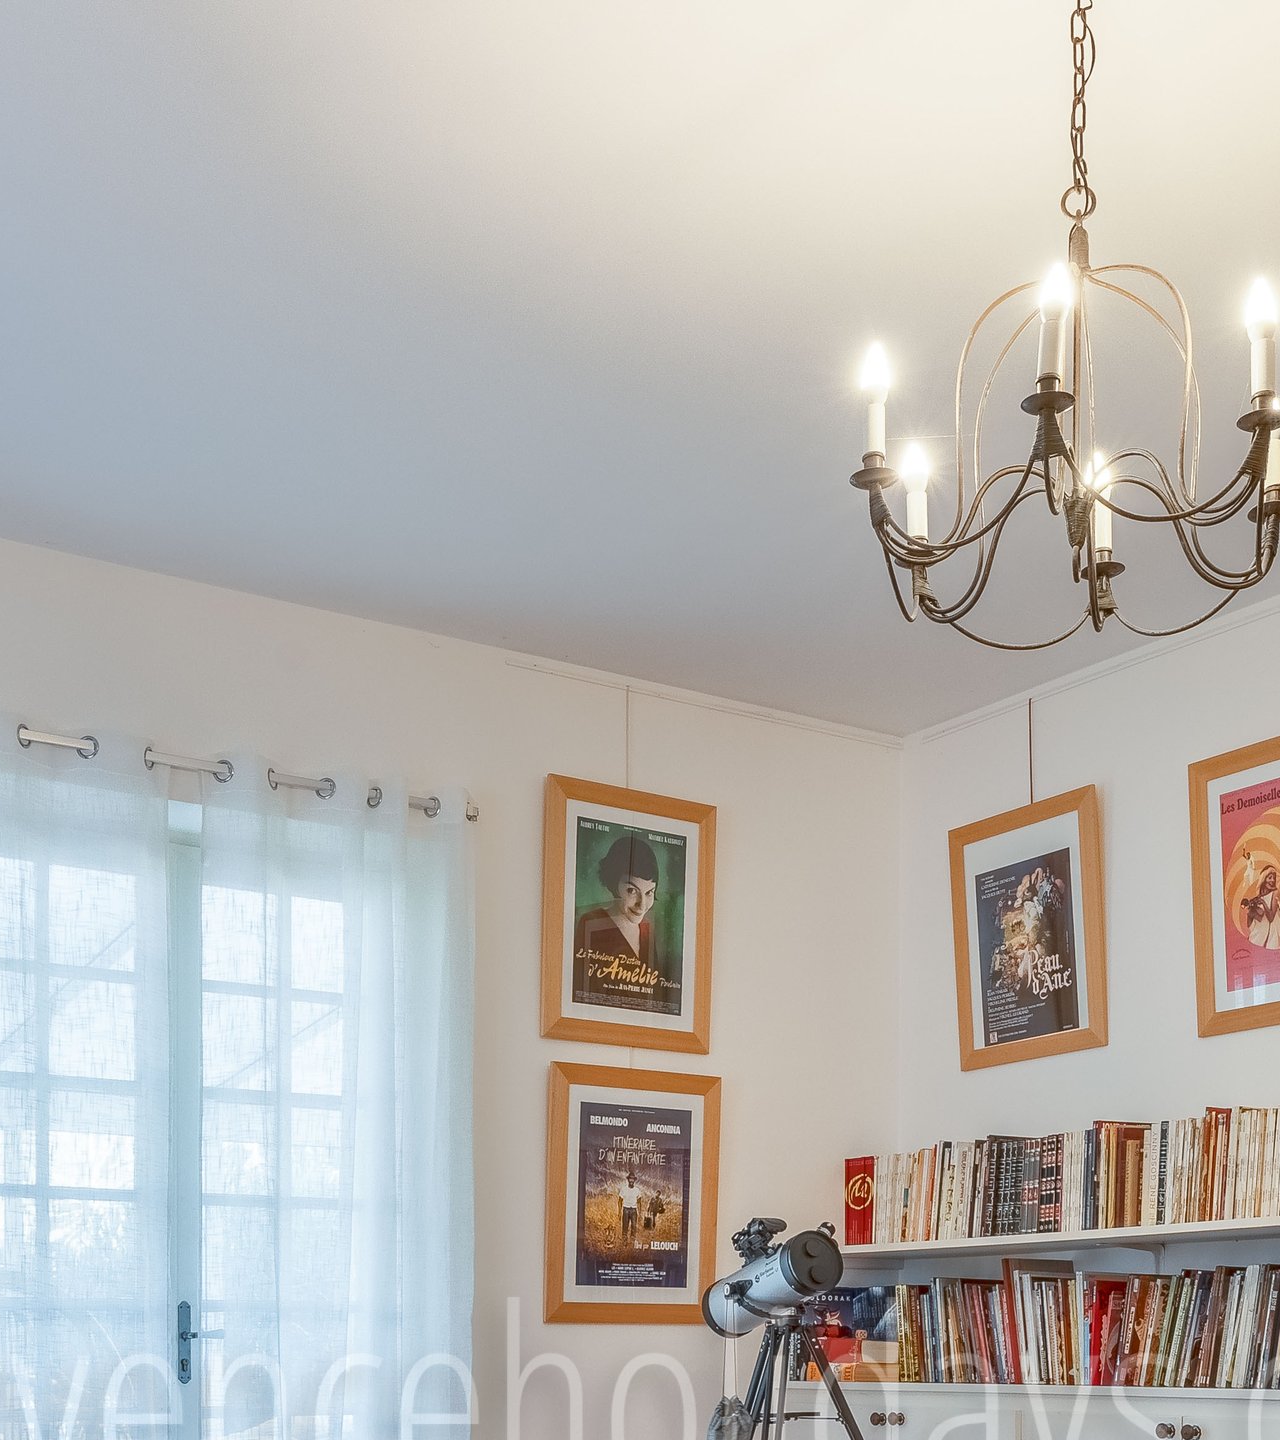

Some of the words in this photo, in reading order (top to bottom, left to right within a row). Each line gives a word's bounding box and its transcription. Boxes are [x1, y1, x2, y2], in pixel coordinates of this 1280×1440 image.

[1221, 799, 1236, 815] Les
[590, 1115, 628, 1127] BELMONDO
[646, 1123, 681, 1135] ANCONINA
[617, 1150, 646, 1164] ENFANT
[650, 1241, 679, 1251] LELOUCH
